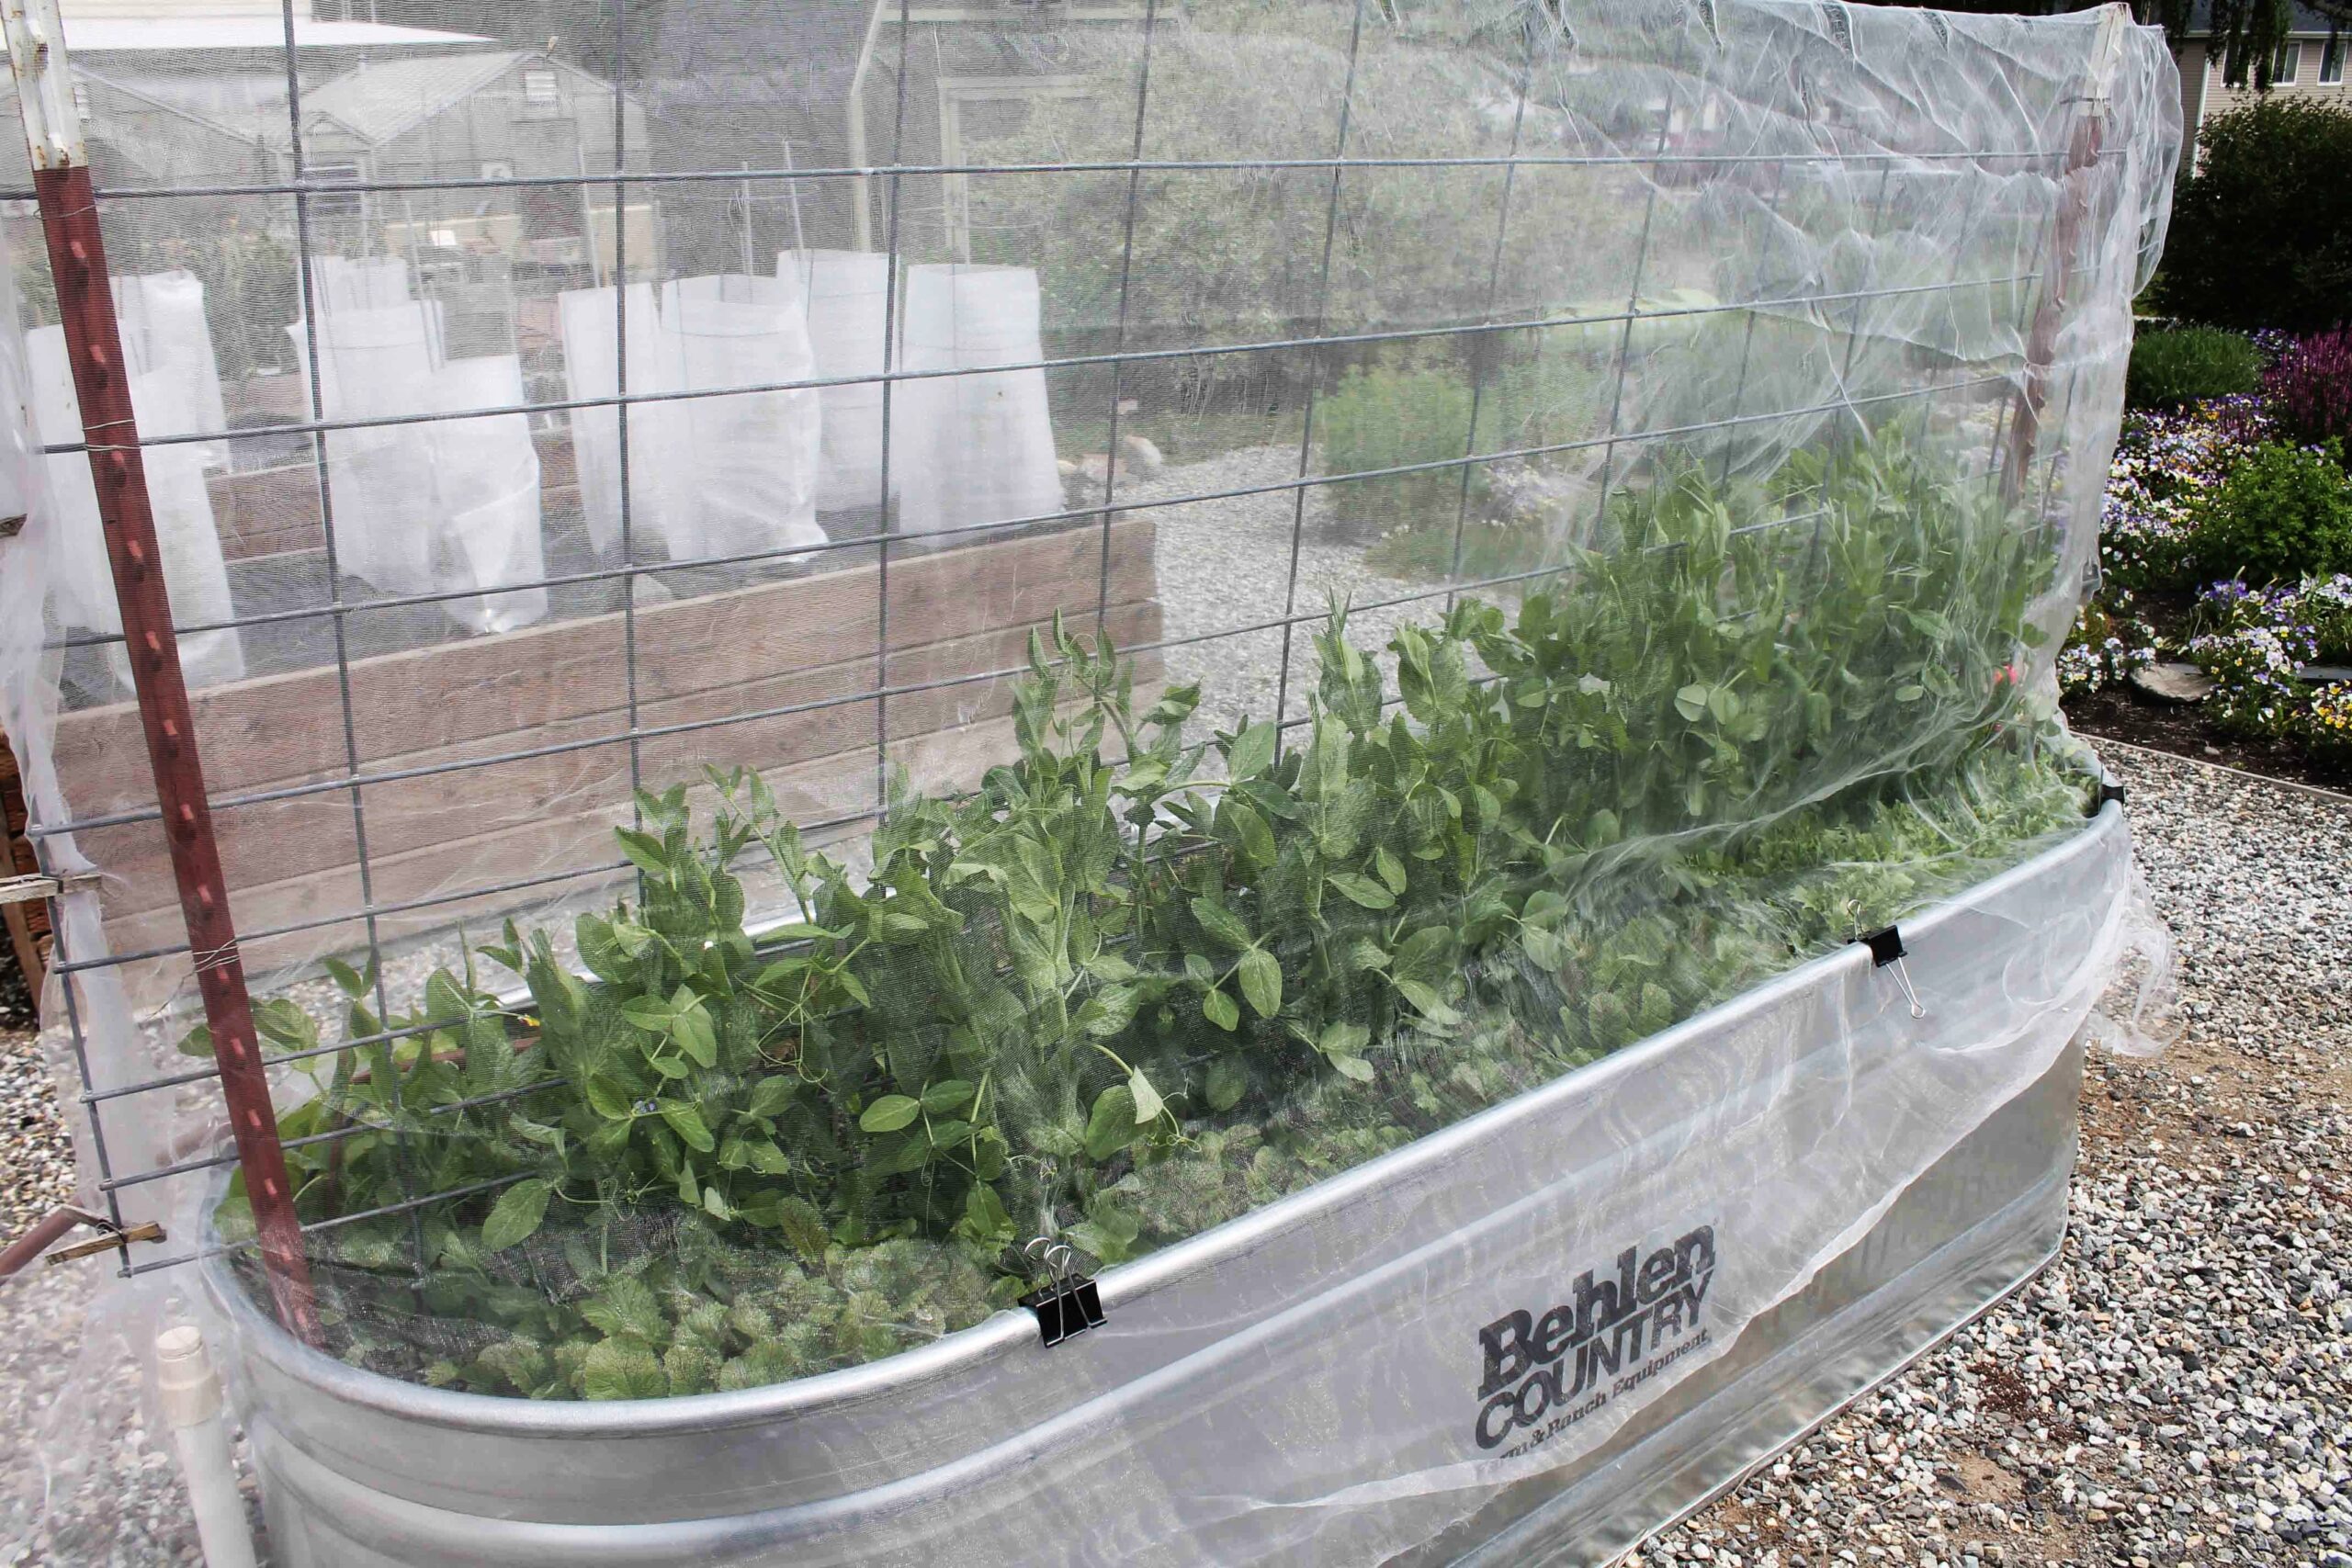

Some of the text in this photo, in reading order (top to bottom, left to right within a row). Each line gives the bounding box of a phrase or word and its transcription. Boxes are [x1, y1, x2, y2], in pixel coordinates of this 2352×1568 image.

[1476, 1269, 1714, 1450] COUNTRY
[1477, 1224, 1715, 1401] Behlen
[1530, 1429, 1545, 1448] &
[1546, 1392, 1607, 1439] Ranch
[1612, 1326, 1709, 1399] Equipment
